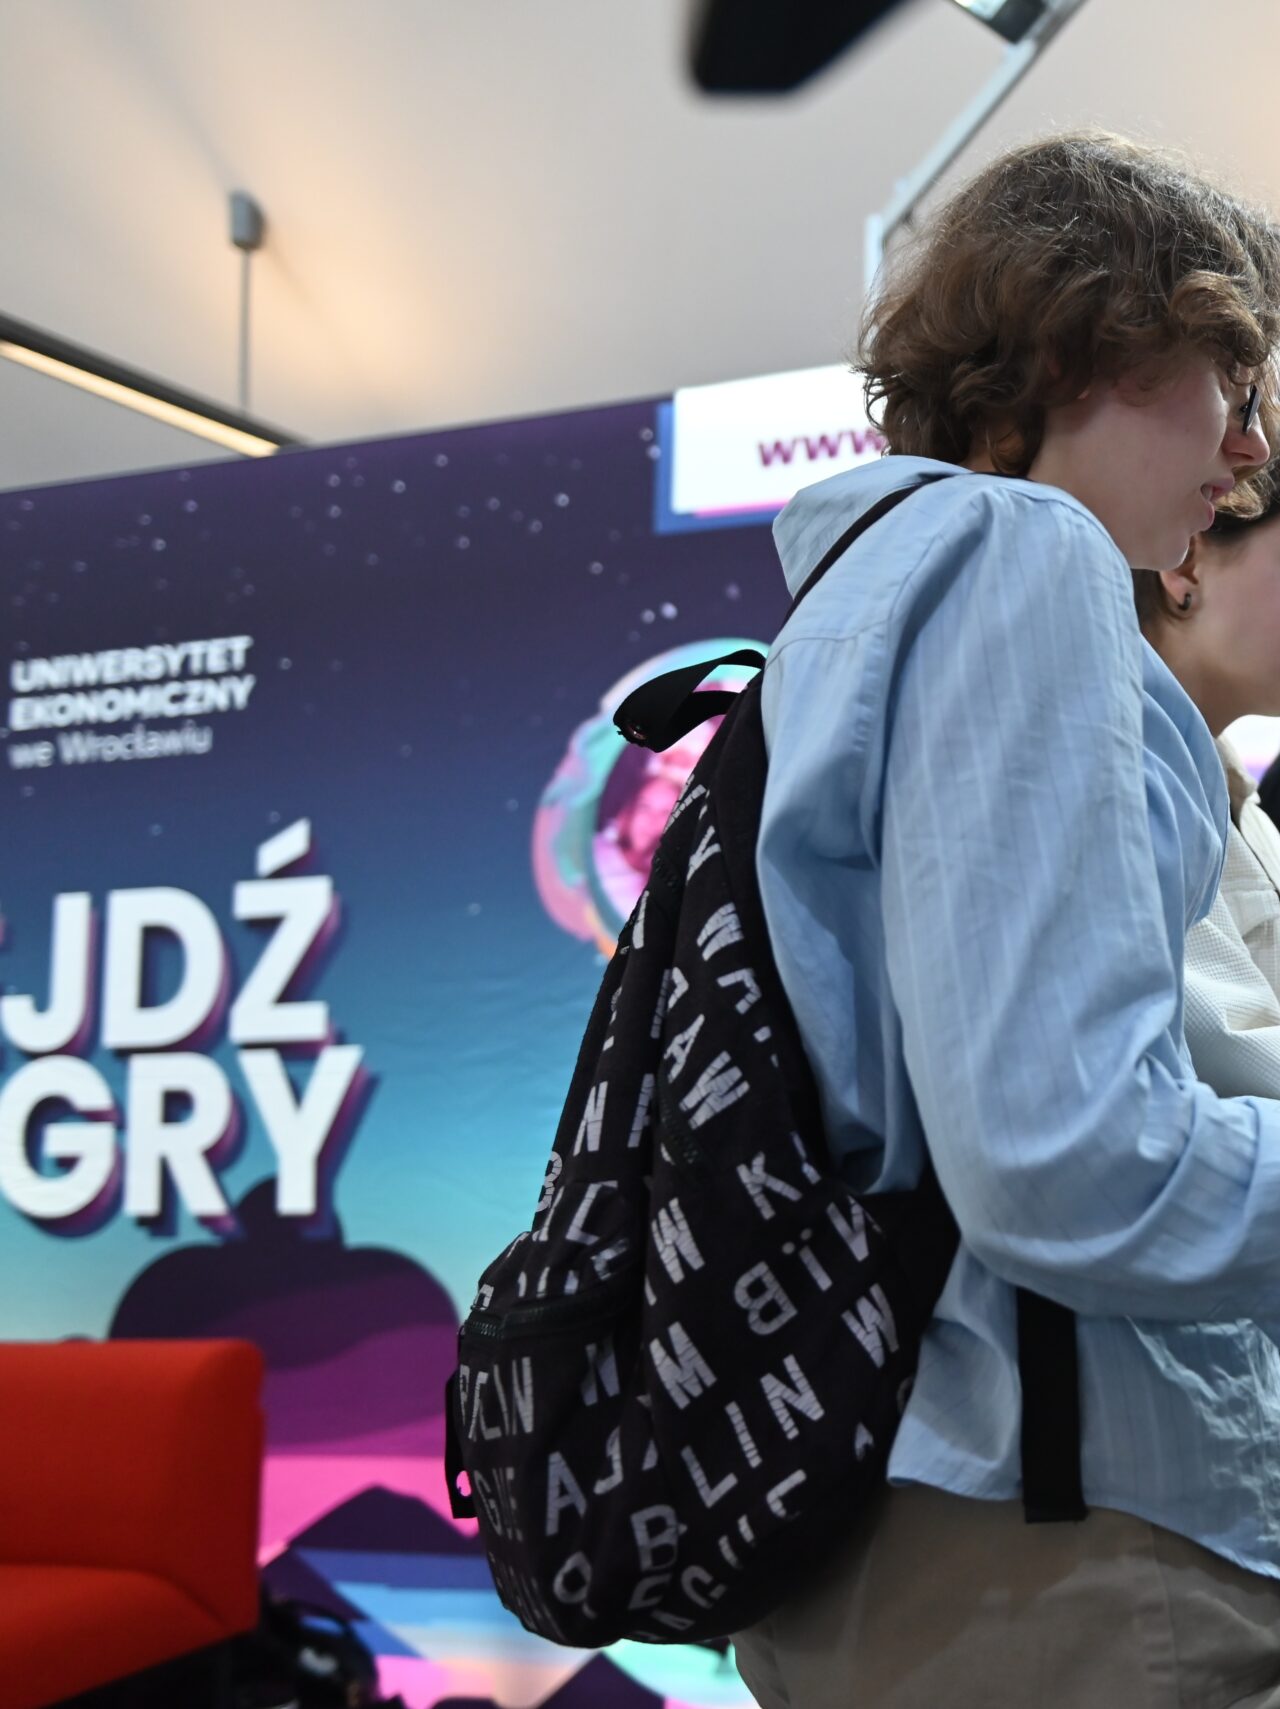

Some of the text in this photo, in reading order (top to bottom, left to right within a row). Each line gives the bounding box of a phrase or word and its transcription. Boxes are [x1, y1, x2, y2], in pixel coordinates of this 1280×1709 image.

[11, 635, 254, 692] UNIWERSYTET
[9, 674, 256, 731] EKONOMICZNY
[8, 719, 213, 769] we Wrocławiu
[0, 1045, 363, 1219] GRY
